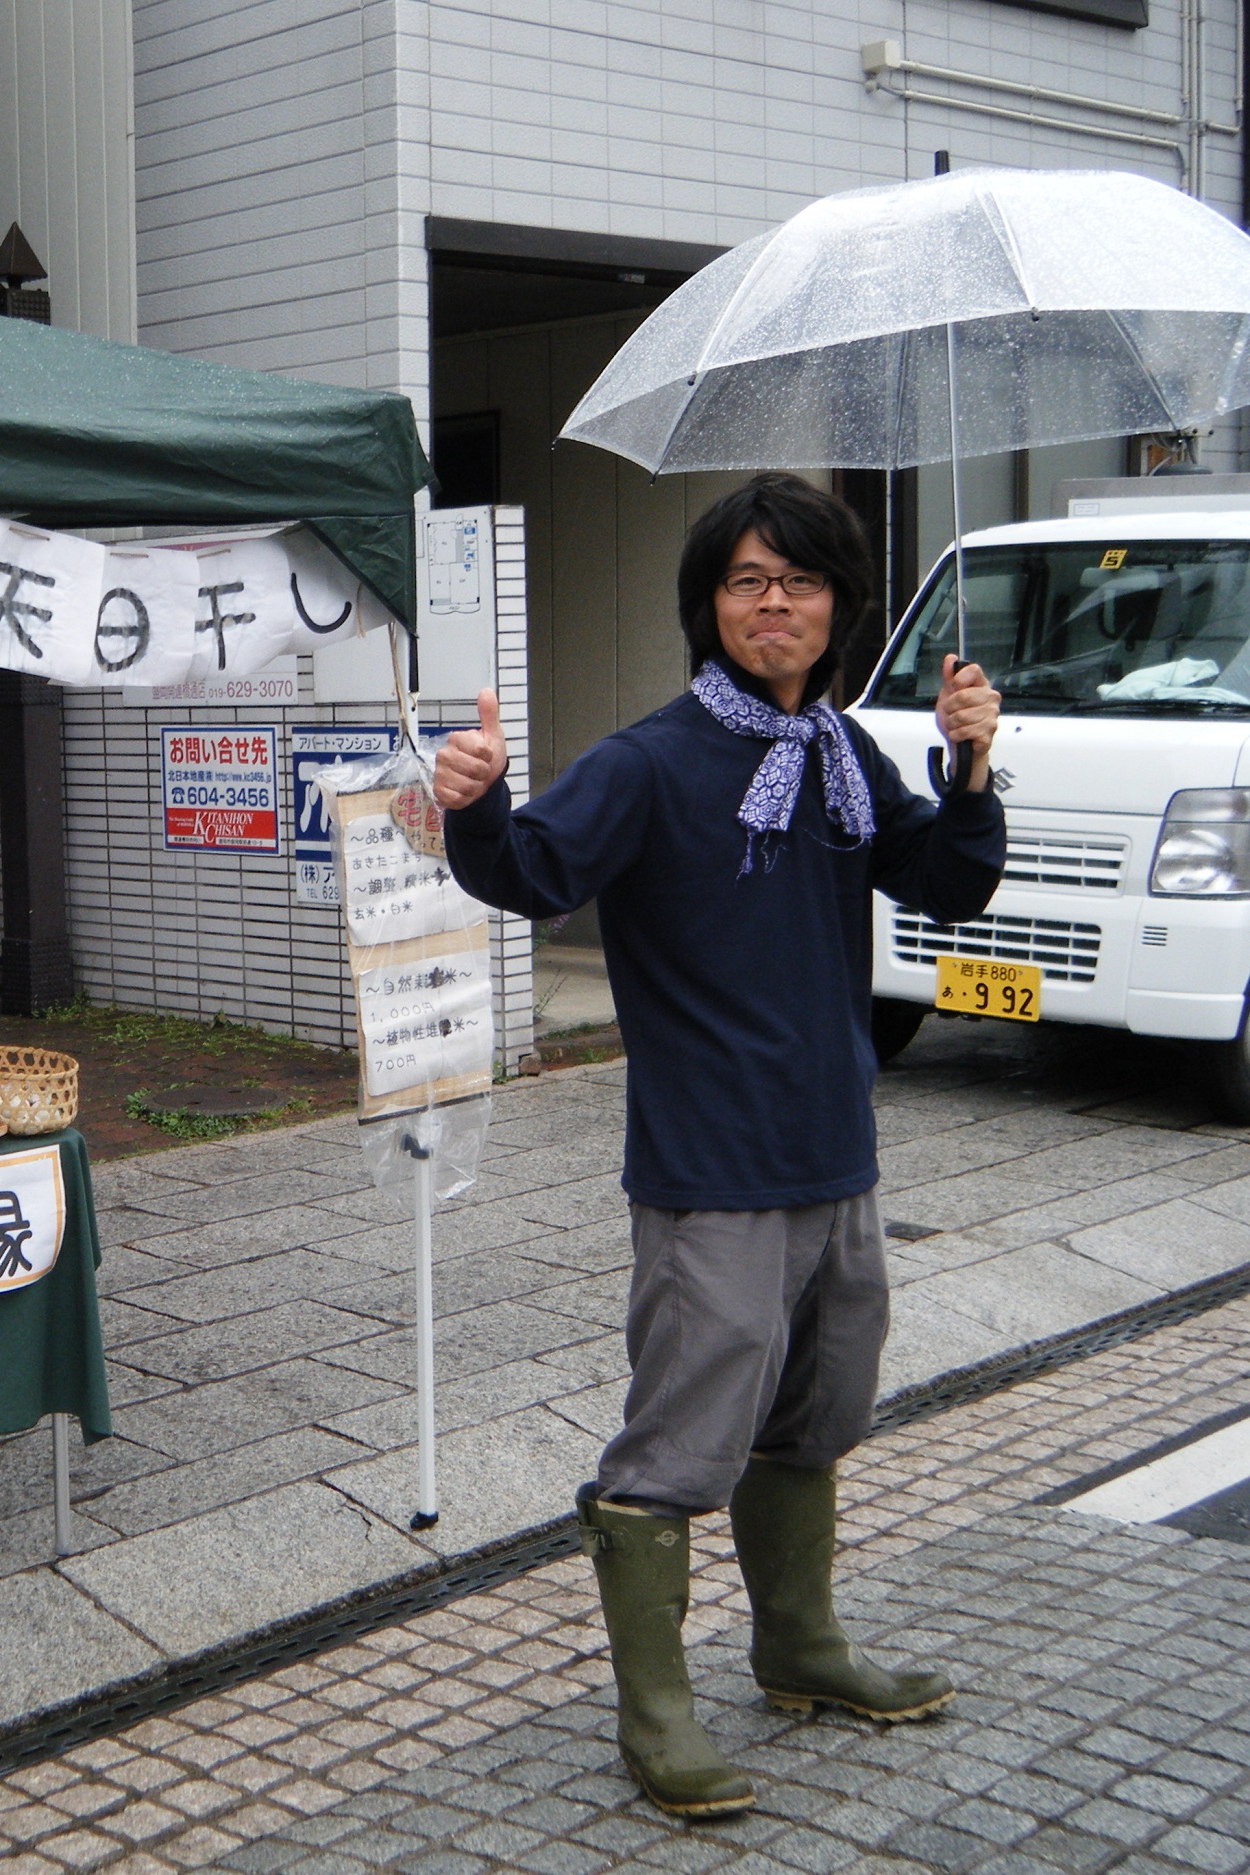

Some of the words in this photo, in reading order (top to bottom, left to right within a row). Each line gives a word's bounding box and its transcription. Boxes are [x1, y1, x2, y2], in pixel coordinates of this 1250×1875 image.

[170, 736, 268, 765] お問い合せ先
[299, 737, 382, 751] アパート・マンション
[187, 786, 269, 808] 604-3456
[193, 811, 253, 835] KITANIHON
[205, 823, 245, 844] CHISAN
[376, 1053, 417, 1073] 700円
